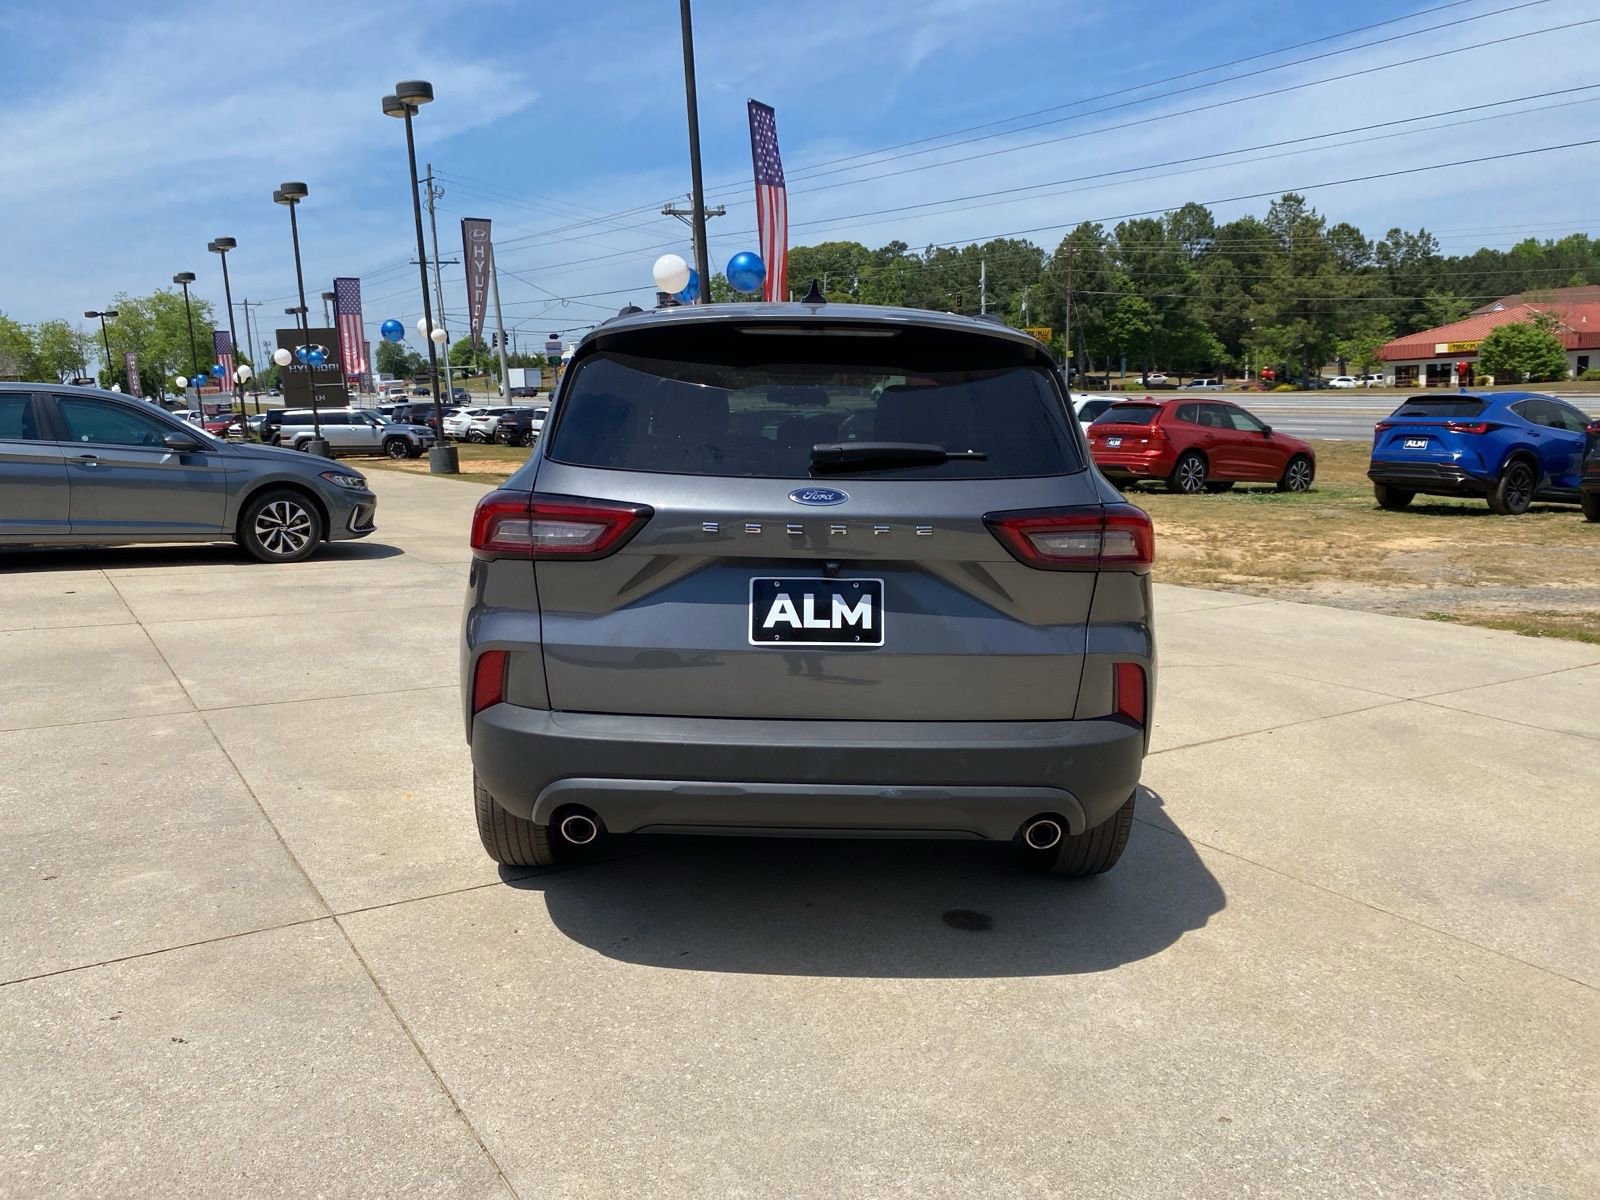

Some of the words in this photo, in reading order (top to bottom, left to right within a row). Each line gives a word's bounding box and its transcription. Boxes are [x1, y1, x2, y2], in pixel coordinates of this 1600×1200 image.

[472, 245, 485, 343] HYUNDAI
[802, 490, 835, 501] Ford
[702, 521, 933, 536] ESCAPE
[762, 593, 872, 630] ALM
